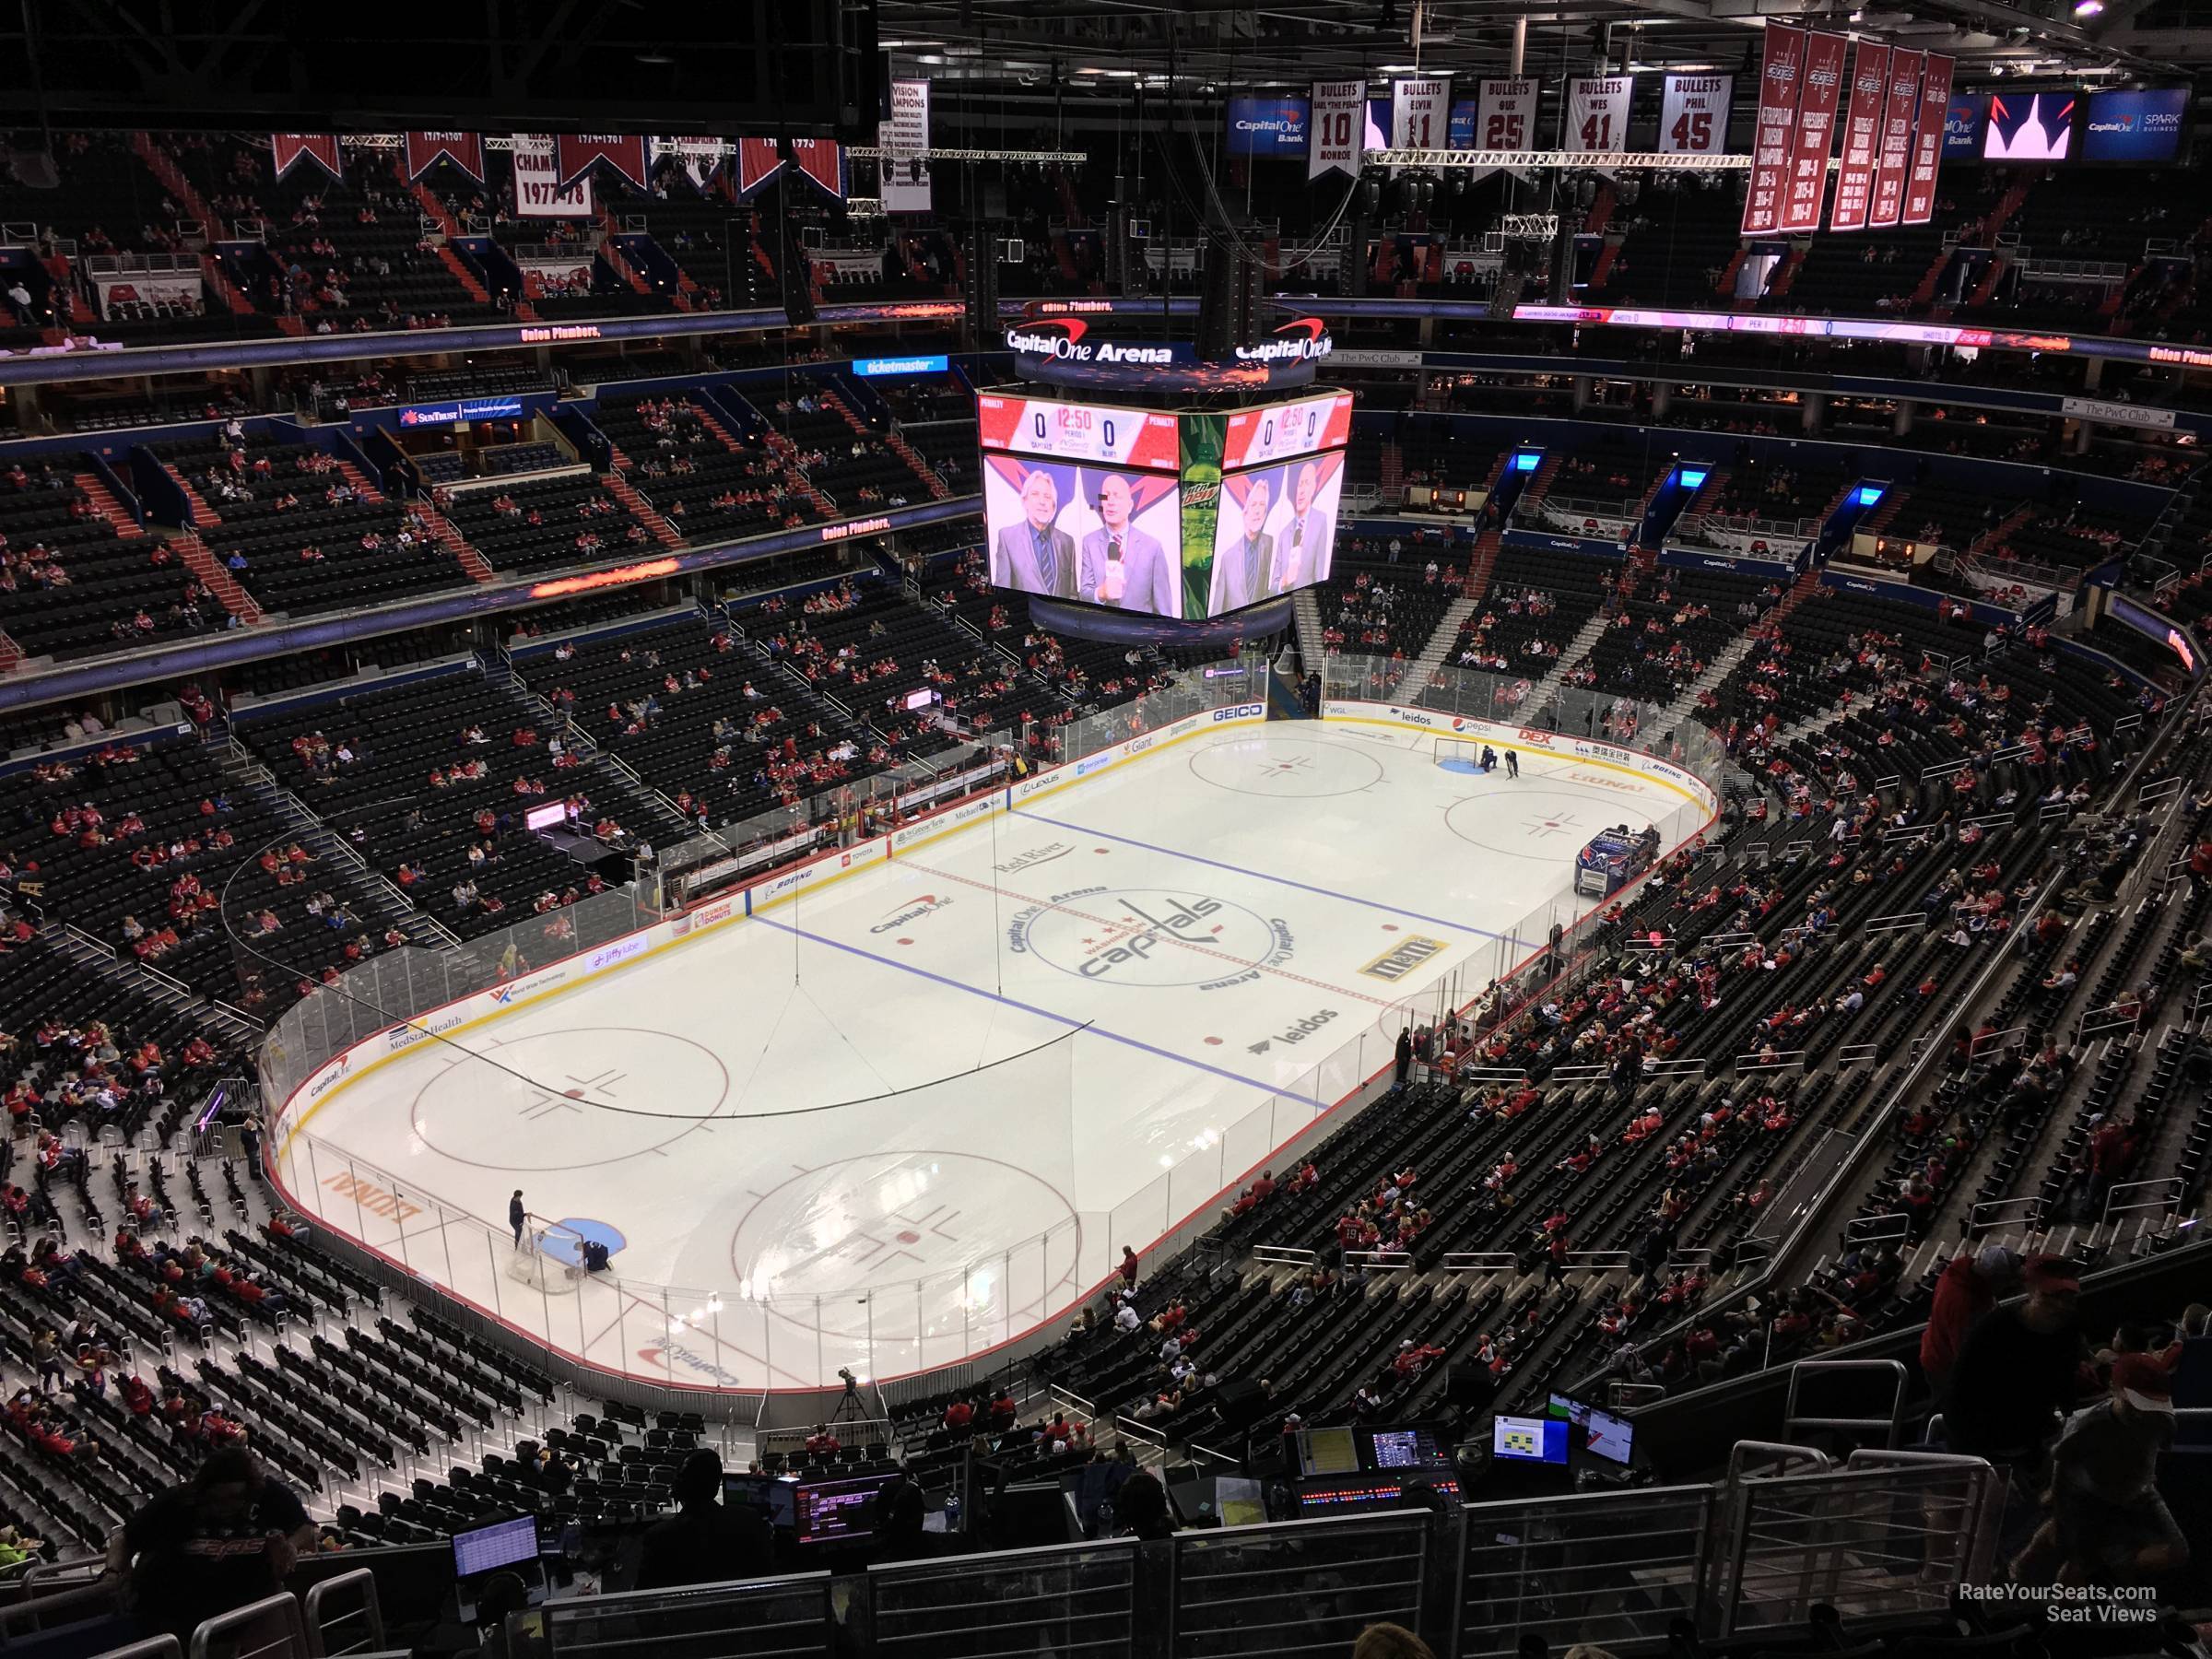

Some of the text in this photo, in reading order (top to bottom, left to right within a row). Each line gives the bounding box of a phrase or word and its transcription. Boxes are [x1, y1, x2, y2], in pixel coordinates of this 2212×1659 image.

[892, 87, 919, 96] VISION
[1321, 84, 1358, 97] BULLETS
[1403, 83, 1441, 96] BULLETS
[1488, 82, 1530, 95] BULLETS
[1579, 81, 1622, 94] BULLETS
[1674, 79, 1722, 93] BULLETS
[892, 99, 925, 108] AMPIONS
[1410, 100, 1432, 110] ELVIN
[1499, 100, 1516, 111] GUS
[1590, 100, 1607, 110] WES
[1685, 98, 1707, 109] PHIL
[2145, 114, 2182, 125] SPARK
[1322, 113, 1352, 146] 10
[1406, 113, 1430, 147] 11
[1486, 114, 1524, 149] 25
[1581, 114, 1611, 149] 41
[1671, 112, 1712, 149] 45
[1277, 135, 1303, 143] Bank
[1948, 135, 1973, 146] Bank
[1320, 151, 1351, 160] MONROE
[1779, 318, 1806, 334] 12:50
[521, 325, 601, 343] Union Plumbers,
[1095, 343, 1172, 363] Arena
[1340, 353, 1400, 363] The PwC Club
[2149, 347, 2182, 361] Union
[866, 359, 930, 374] ticketmaster
[981, 398, 1004, 409] PENALTY
[1058, 407, 1092, 429] 12:50
[1281, 407, 1303, 429] 12:50
[2086, 404, 2151, 422] The PwC Club
[1035, 413, 1046, 439] 0
[1148, 417, 1175, 428] PENALTY
[1307, 411, 1316, 437] 0
[1103, 420, 1115, 447] 0
[1264, 420, 1273, 446] 0
[822, 518, 891, 541] Union Plumbers,
[1213, 704, 1263, 722] GEICO
[1402, 712, 1431, 725] leidos
[1467, 722, 1492, 732] pepsi
[1518, 730, 1553, 745] DEX
[1132, 737, 1152, 754] Giant
[1525, 741, 1556, 751] imaging
[1652, 763, 1683, 780] BOEING
[1030, 774, 1060, 789] LEXUS
[955, 806, 980, 820] Michael
[852, 848, 874, 861] TOYOTA
[992, 841, 1065, 874] Red River
[777, 870, 813, 890] BOEING
[1051, 887, 1108, 903] Arena
[704, 907, 732, 925] DONUTS
[605, 942, 640, 964] jiffy lube
[511, 986, 525, 996] World
[538, 971, 566, 985] Technology
[1198, 970, 1262, 992] Arena
[1273, 1008, 1339, 1045] leidos
[391, 1018, 463, 1052] MedStar Health
[1346, 1229, 1358, 1240] 19
